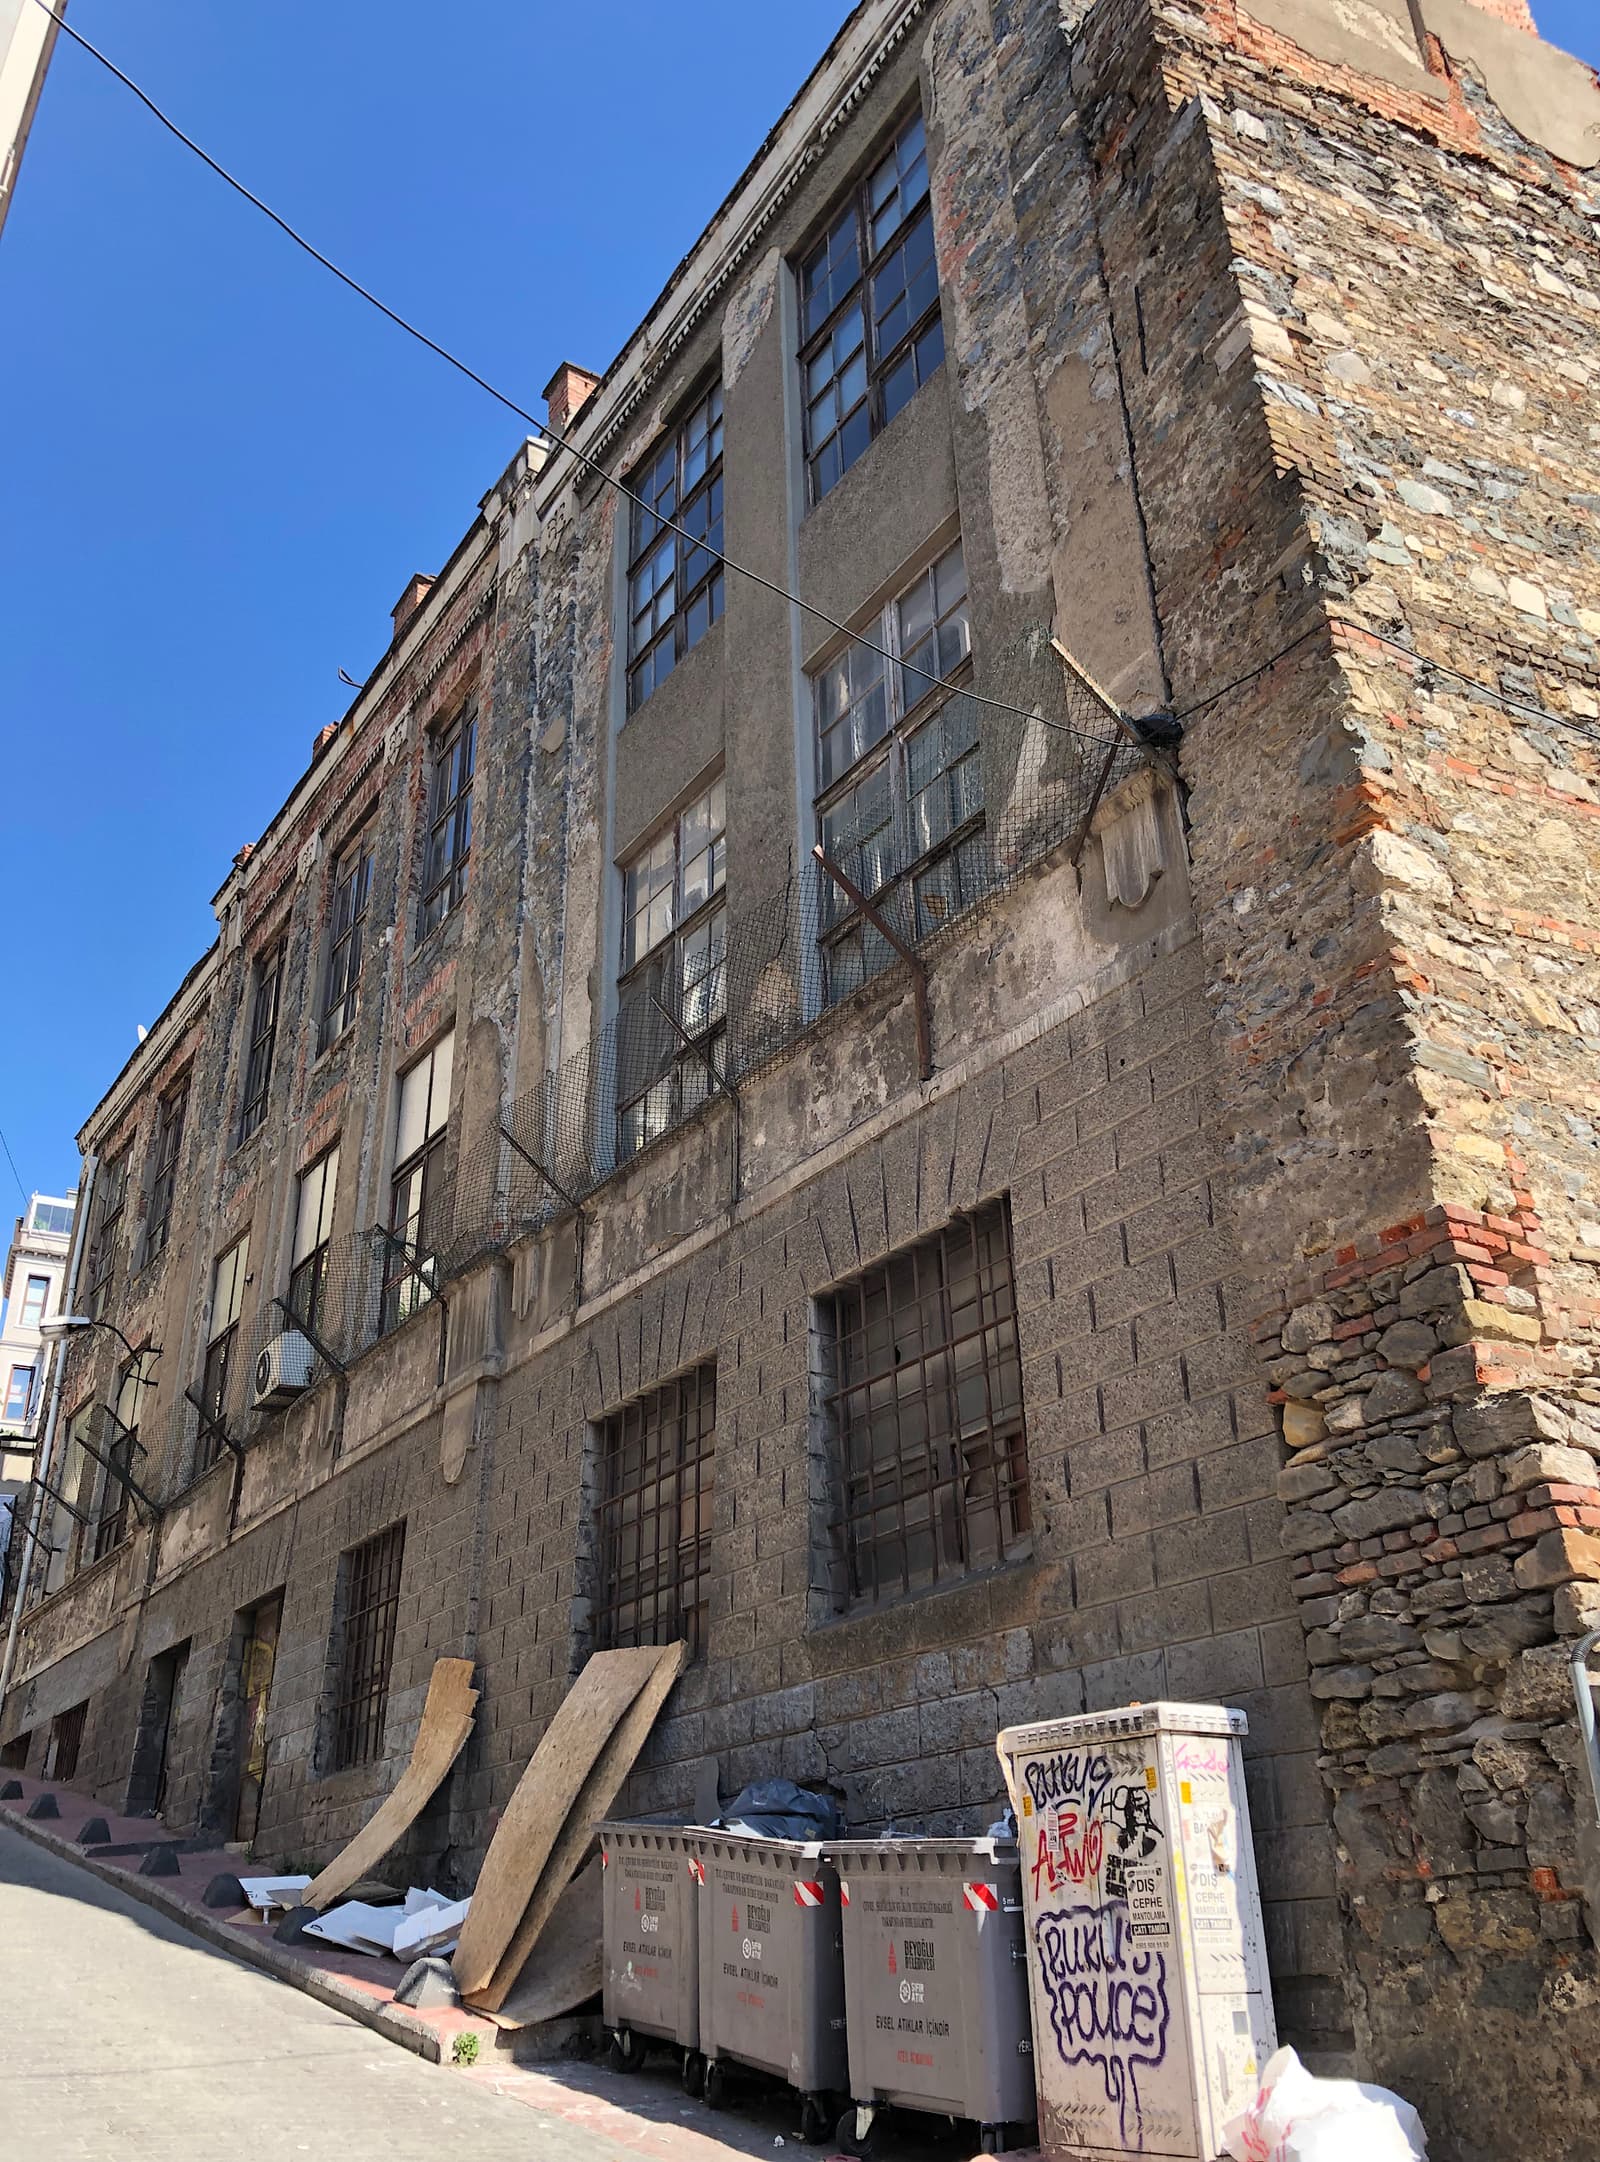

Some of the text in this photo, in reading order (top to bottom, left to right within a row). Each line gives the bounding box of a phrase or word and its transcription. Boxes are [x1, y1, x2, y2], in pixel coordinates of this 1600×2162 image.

[1136, 1878, 1155, 1895] DIŞ
[1132, 1897, 1163, 1909] CEPHE
[1195, 1892, 1225, 1903] CEPHE
[1132, 1911, 1166, 1921] MANTOLAMA
[903, 1938, 935, 1957] BEYOĞLU
[876, 2015, 895, 2031] EVSEL
[897, 2017, 924, 2034] ATIKLAR
